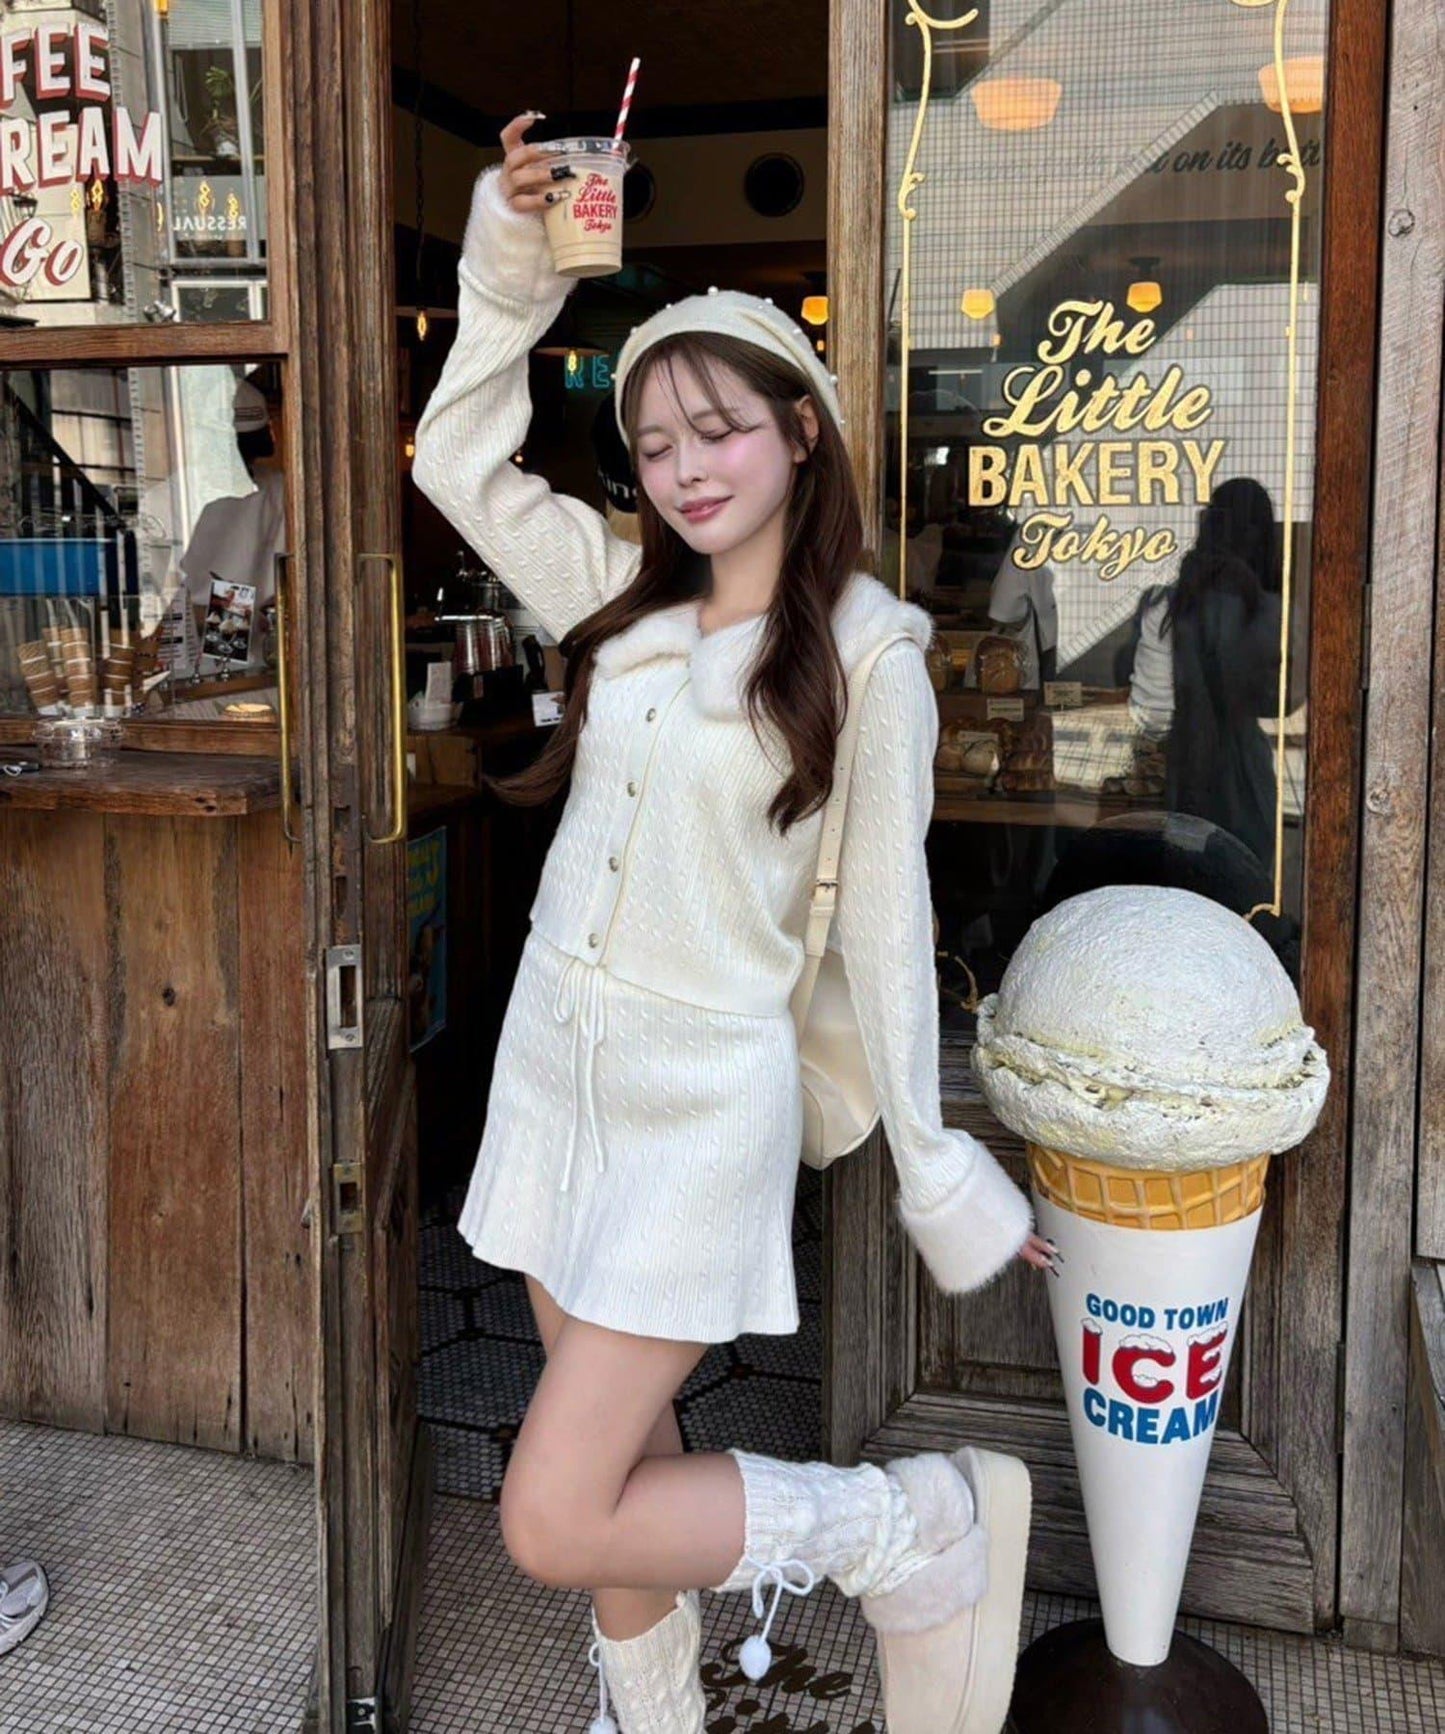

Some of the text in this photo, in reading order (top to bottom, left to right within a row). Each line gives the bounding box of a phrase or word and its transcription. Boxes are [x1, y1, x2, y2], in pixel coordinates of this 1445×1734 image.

[0, 22, 111, 107] FEE
[0, 106, 163, 191] REAM
[585, 173, 608, 187] The
[1173, 151, 1213, 172] on
[1216, 140, 1250, 170] its
[573, 203, 617, 219] BAKERY
[576, 187, 616, 202] Little
[584, 219, 612, 233] Tokyo
[0, 217, 83, 287] Go
[1037, 299, 1156, 364] The
[982, 363, 1214, 428] Little
[968, 439, 1225, 506] BAKERY
[1012, 511, 1178, 581] Tokyo
[1086, 1293, 1229, 1330] GOOD TOWN
[1081, 1317, 1229, 1404] ICE
[1083, 1387, 1219, 1444] CREAM
